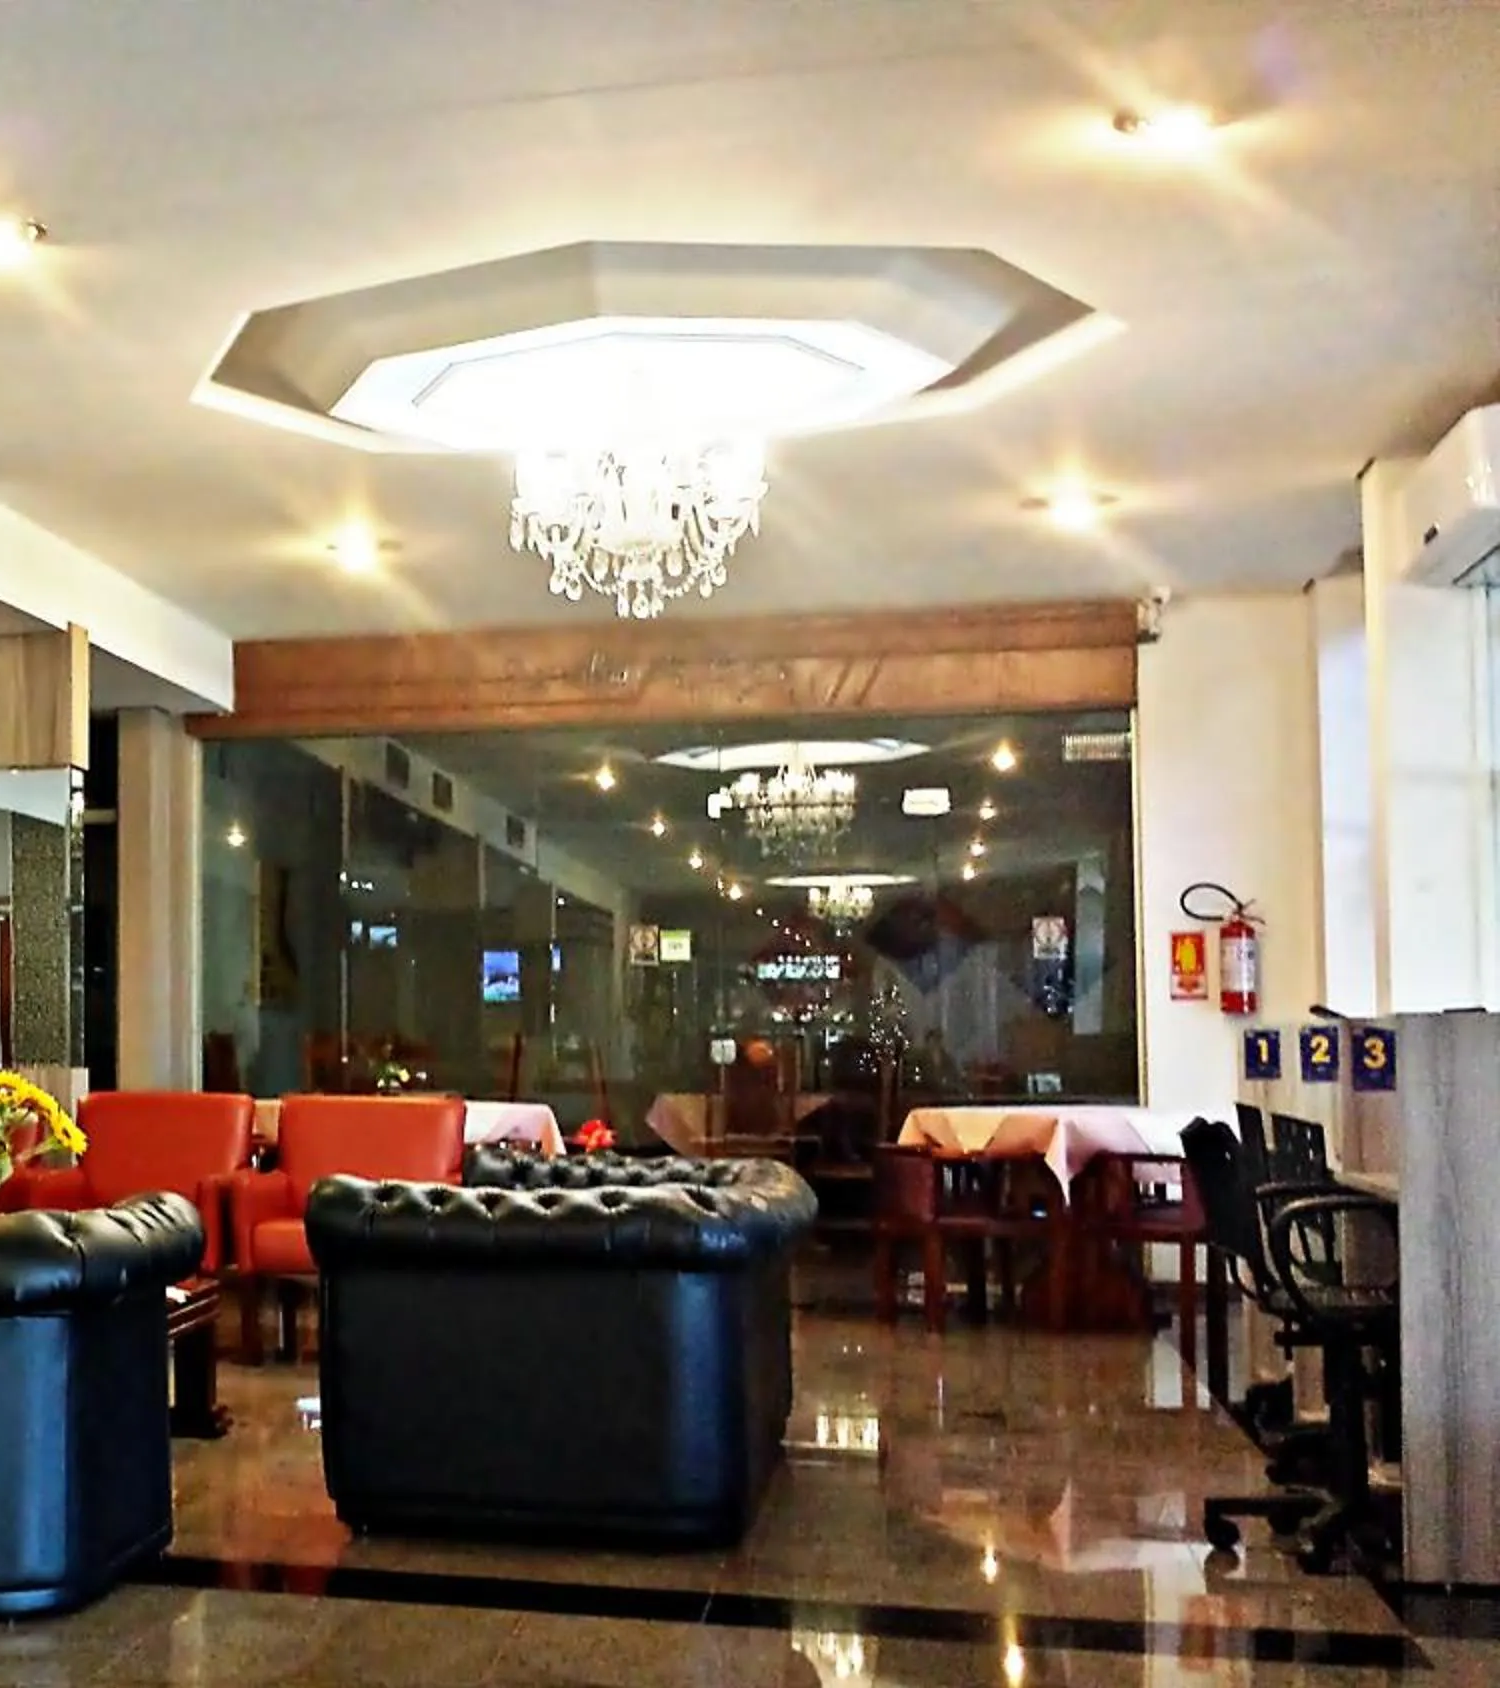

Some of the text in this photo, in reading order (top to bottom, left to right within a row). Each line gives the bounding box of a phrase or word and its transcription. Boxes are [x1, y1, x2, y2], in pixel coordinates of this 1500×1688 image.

[1257, 1039, 1269, 1063] 1
[1310, 1035, 1331, 1063] 2
[1363, 1037, 1387, 1069] 3
